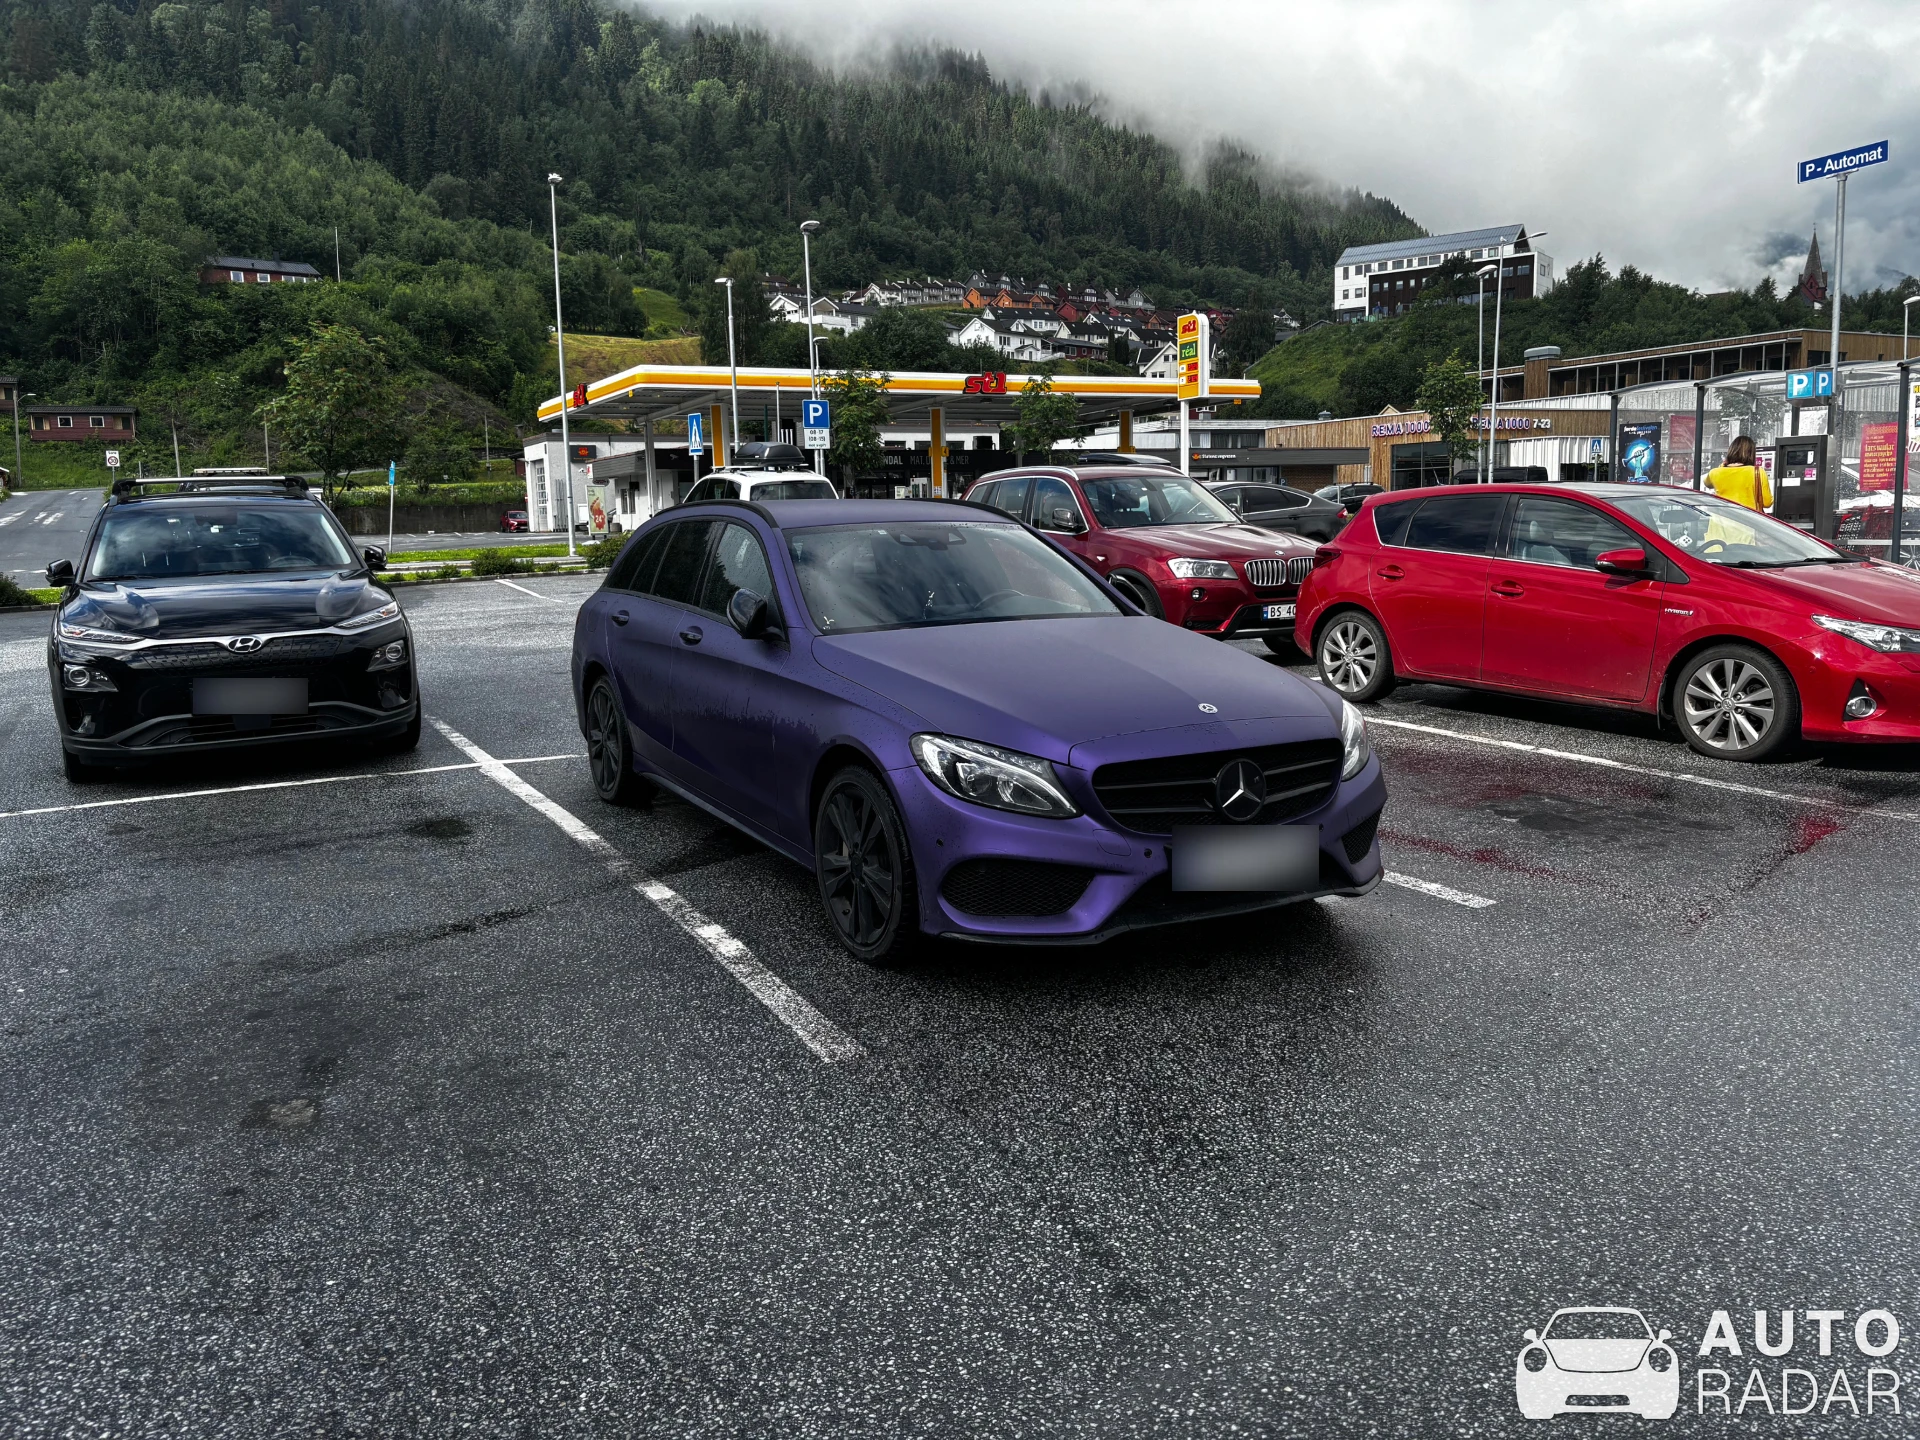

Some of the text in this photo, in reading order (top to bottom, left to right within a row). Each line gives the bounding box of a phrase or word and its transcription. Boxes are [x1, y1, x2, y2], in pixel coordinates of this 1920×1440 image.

[1806, 163, 1815, 177] P
[1824, 146, 1882, 172] Automat
[965, 371, 1007, 394] st1
[1792, 374, 1808, 396] P
[1818, 373, 1829, 394] P
[809, 403, 823, 425] P
[1505, 416, 1530, 430] 1000
[1533, 418, 1551, 429] 7-23
[1371, 420, 1431, 437] REMA 1000
[1270, 606, 1296, 617] BS 40
